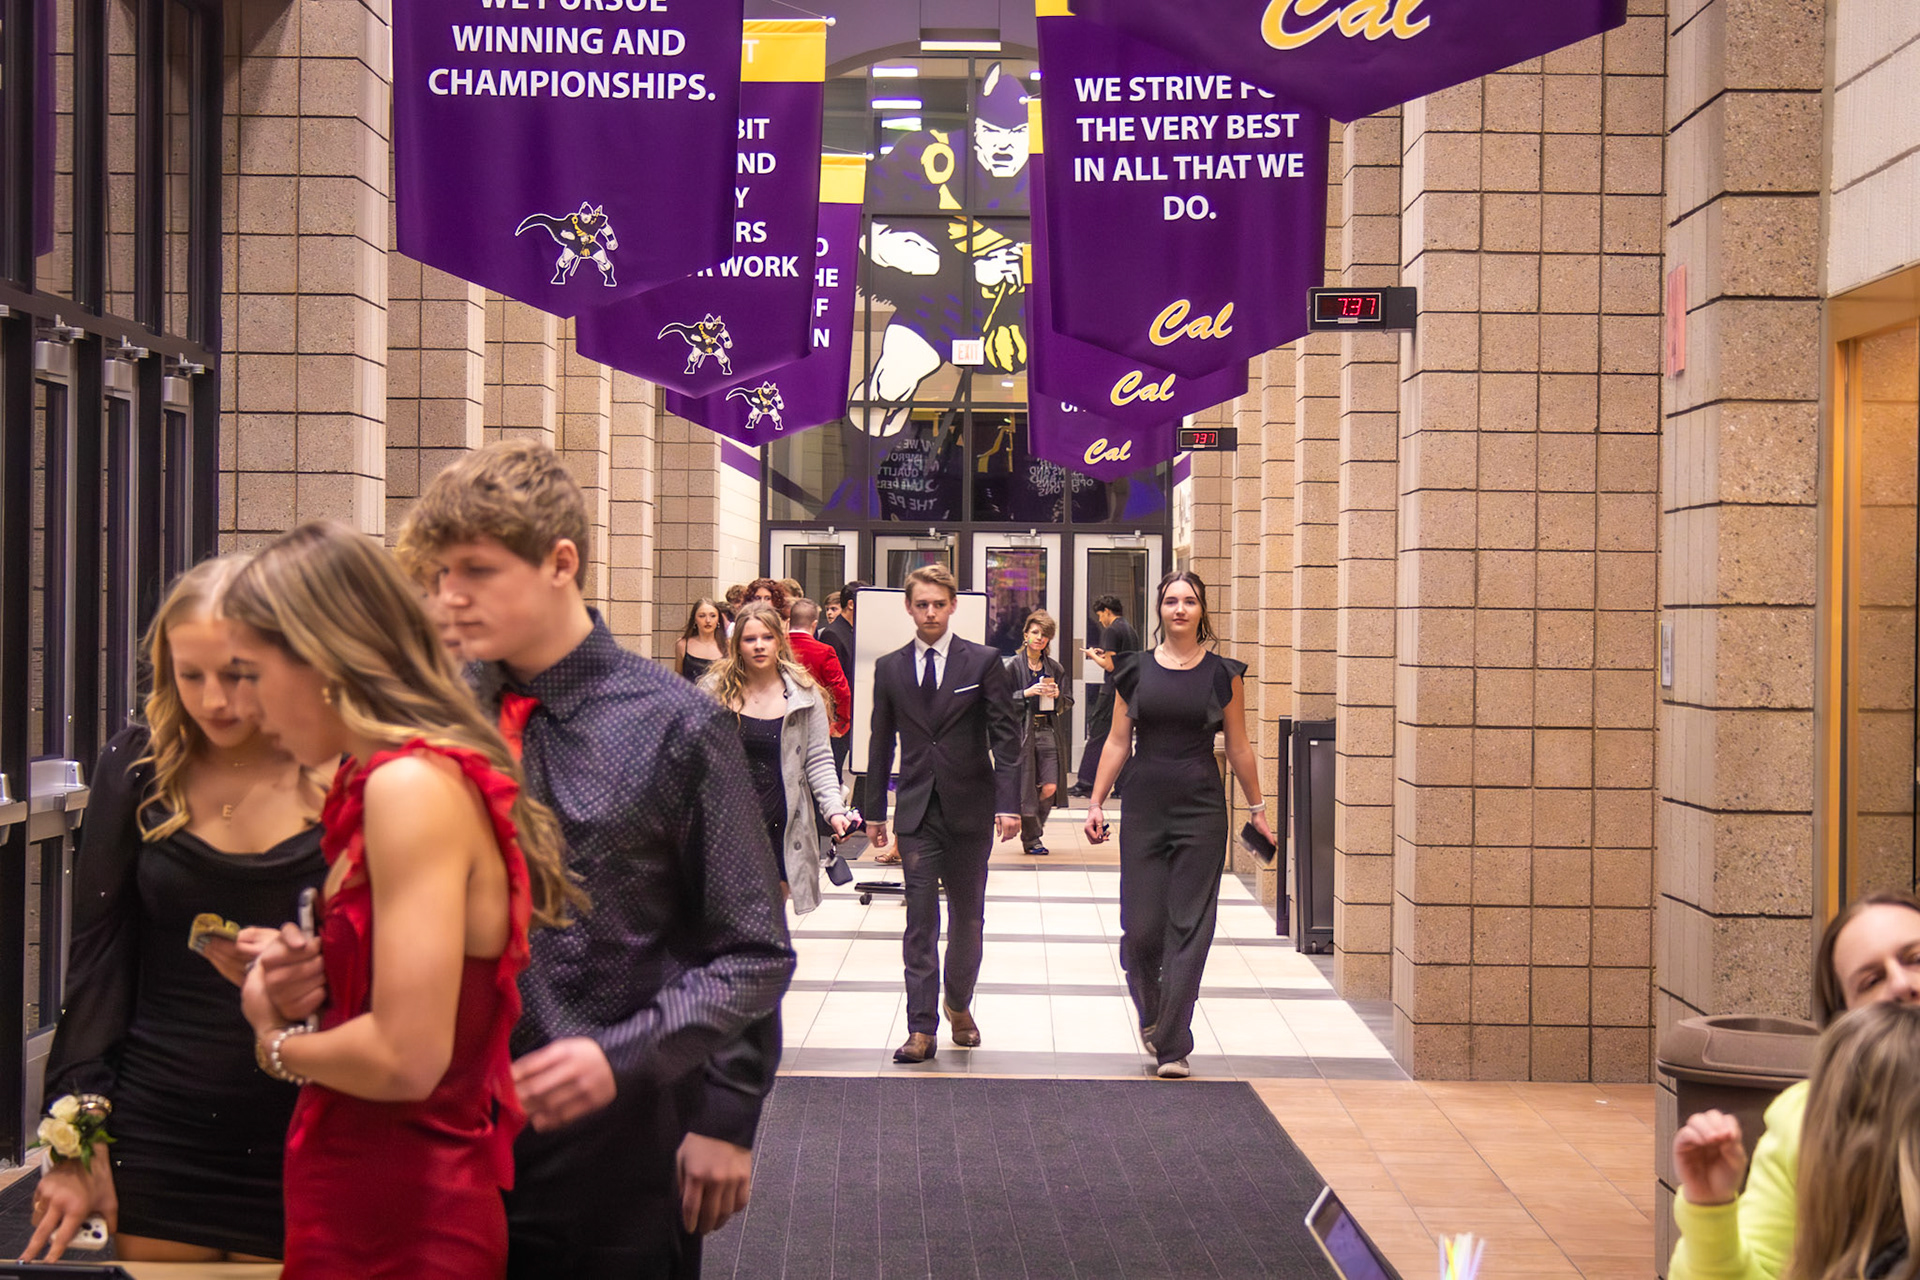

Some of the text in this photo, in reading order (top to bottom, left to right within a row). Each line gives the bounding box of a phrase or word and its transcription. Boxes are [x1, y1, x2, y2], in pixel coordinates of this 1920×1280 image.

[452, 25, 686, 56] WINNING AND
[428, 68, 716, 101] CHAMPIONSHIPS.
[1074, 77, 1122, 102] WE
[1128, 75, 1233, 101] STRIVE
[1076, 113, 1300, 142] THE VERY BEST
[1074, 153, 1304, 182] IN ALL THAT WE
[1163, 195, 1217, 221] DO.
[720, 256, 799, 277] WORK
[1149, 298, 1234, 346] Cal
[958, 343, 980, 361] EXIT
[1110, 370, 1176, 406] Cal
[1084, 438, 1132, 464] Cal
